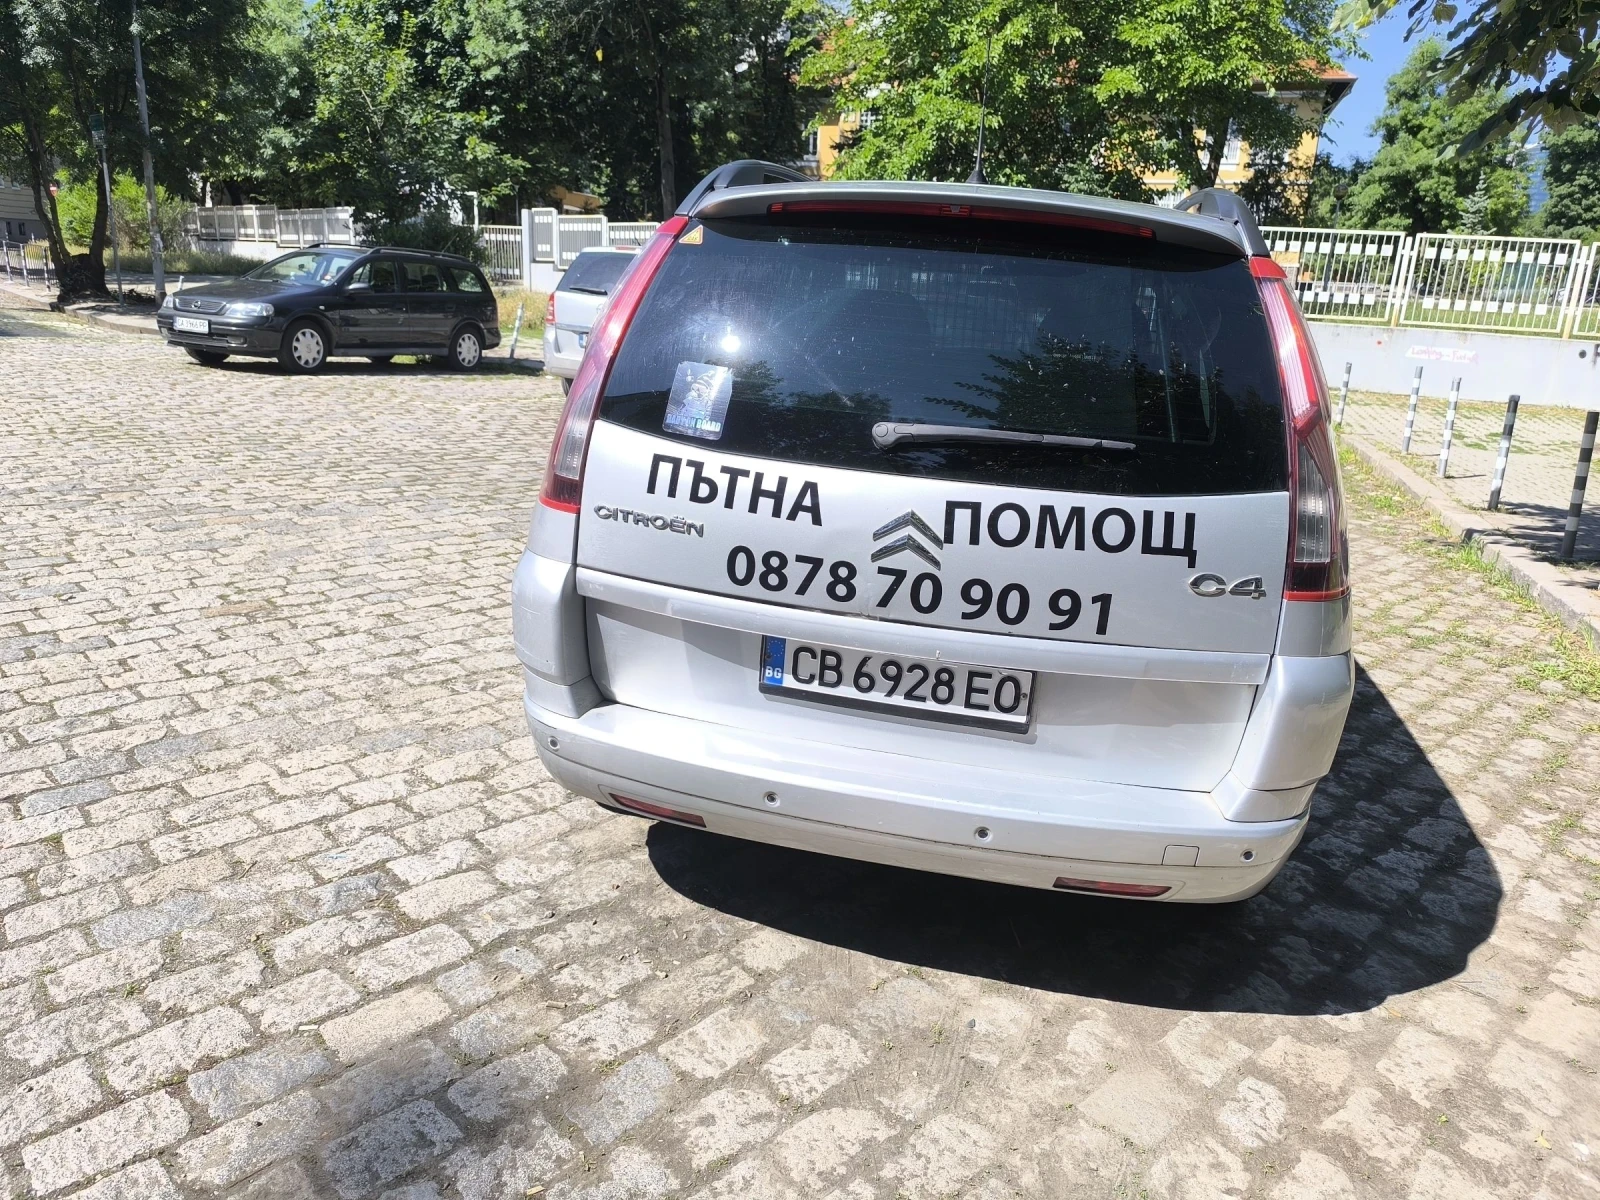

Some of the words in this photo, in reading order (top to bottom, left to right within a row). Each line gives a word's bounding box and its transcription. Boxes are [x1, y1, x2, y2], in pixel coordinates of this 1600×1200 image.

[696, 418, 722, 432] BOARD
[593, 504, 705, 538] CITROËN
[646, 453, 823, 527] ПЪТНА
[943, 500, 1198, 569] ПОМОЩ
[726, 545, 857, 602] 0878
[875, 566, 943, 614] 70
[960, 578, 1030, 626] 90
[1048, 588, 1113, 636] 91
[1188, 572, 1267, 600] C4
[765, 666, 783, 679] BG
